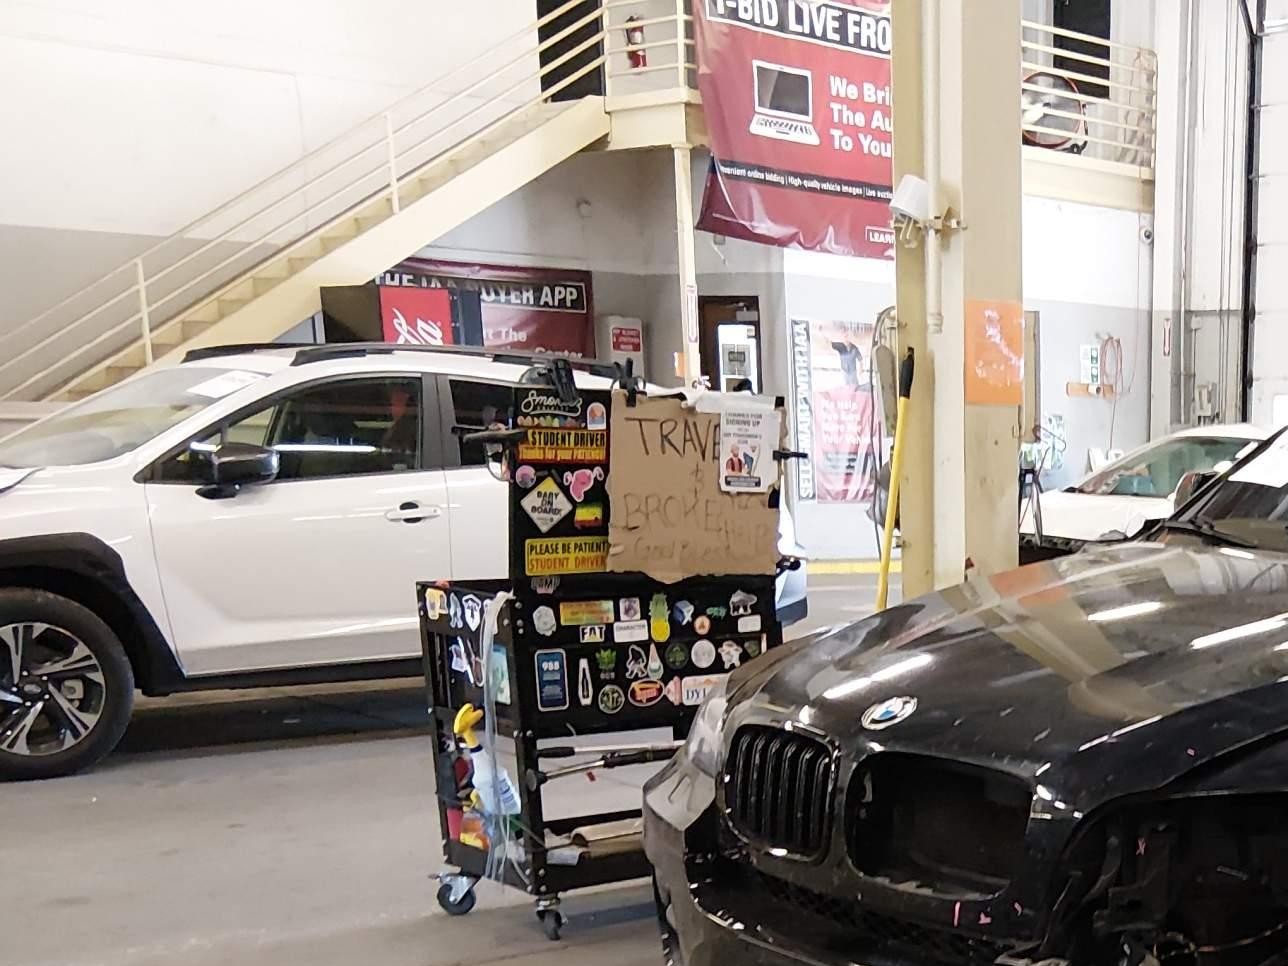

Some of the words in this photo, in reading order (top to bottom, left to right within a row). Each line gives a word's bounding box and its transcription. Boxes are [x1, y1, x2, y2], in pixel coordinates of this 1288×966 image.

[787, 0, 842, 41] LIVE
[829, 75, 859, 100] We
[863, 83, 889, 106] Bri
[830, 102, 866, 128] The
[830, 130, 854, 152] To
[540, 286, 578, 308] APP
[500, 328, 527, 343] The
[531, 431, 572, 446] STUDENT
[574, 432, 605, 447] DRIVER
[529, 544, 559, 555] PLEASE
[562, 543, 572, 554] BE
[530, 557, 569, 570] STUDENT
